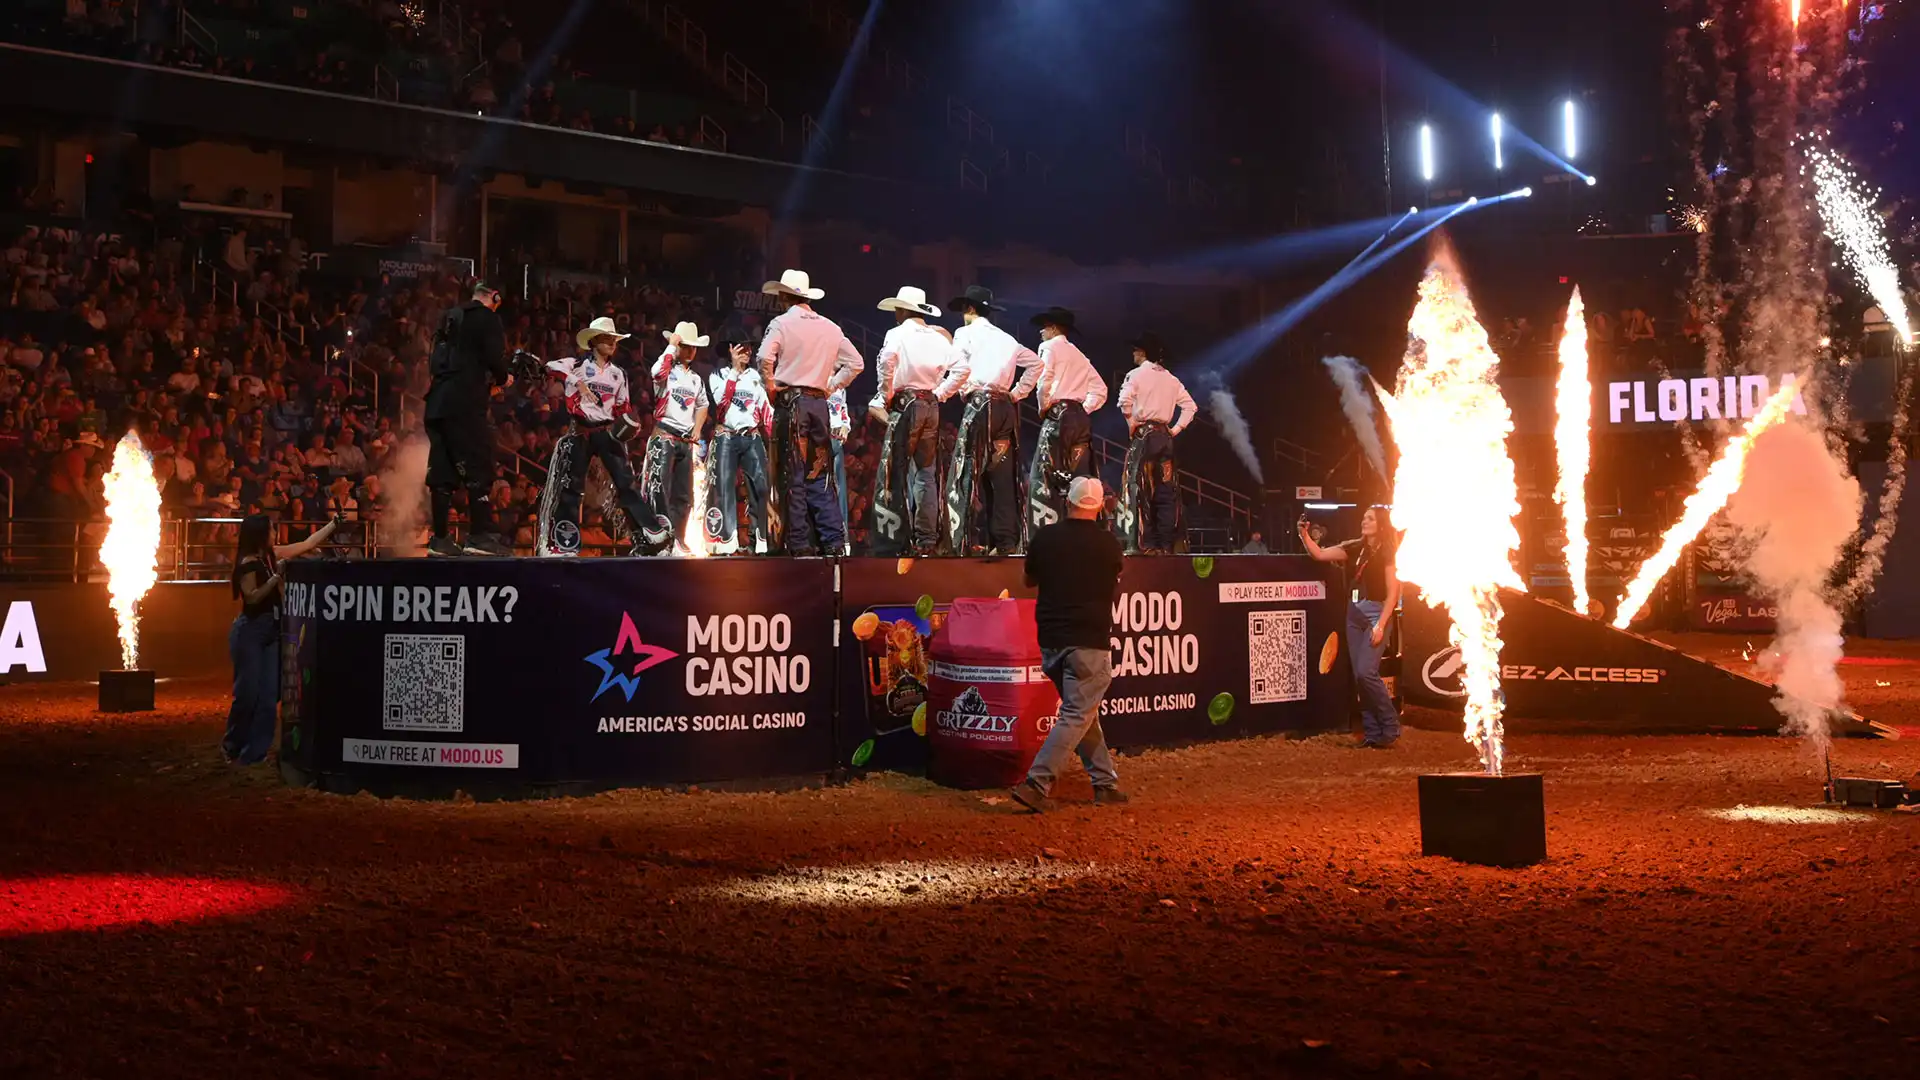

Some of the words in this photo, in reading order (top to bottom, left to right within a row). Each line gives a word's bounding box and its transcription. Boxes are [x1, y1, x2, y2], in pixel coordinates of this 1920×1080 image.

[1608, 373, 1808, 424] FLORIDA
[288, 582, 307, 617] FOR
[308, 583, 316, 618] A
[322, 584, 383, 622] SPIN
[393, 585, 519, 624] BREAK?
[1234, 587, 1252, 600] PLAY
[1255, 586, 1273, 599] FREE
[1274, 585, 1285, 598] AT
[1285, 584, 1319, 598] MODO.US
[1110, 591, 1183, 633] MODO
[687, 612, 792, 654] MODO
[1109, 633, 1199, 678] CASINO
[685, 654, 812, 697] CASINO
[1110, 695, 1151, 715] SOCIAL
[1154, 693, 1196, 712] CASINO
[597, 714, 689, 733] AMERICA'S
[692, 713, 749, 732] SOCIAL
[752, 711, 806, 730] CASINO
[936, 711, 1018, 732] GRIZZLY
[969, 732, 1014, 743] POUCHES
[362, 744, 387, 761] PLAY
[390, 746, 418, 762] FREE
[421, 747, 436, 763] AT
[440, 748, 504, 764] MODO.US
